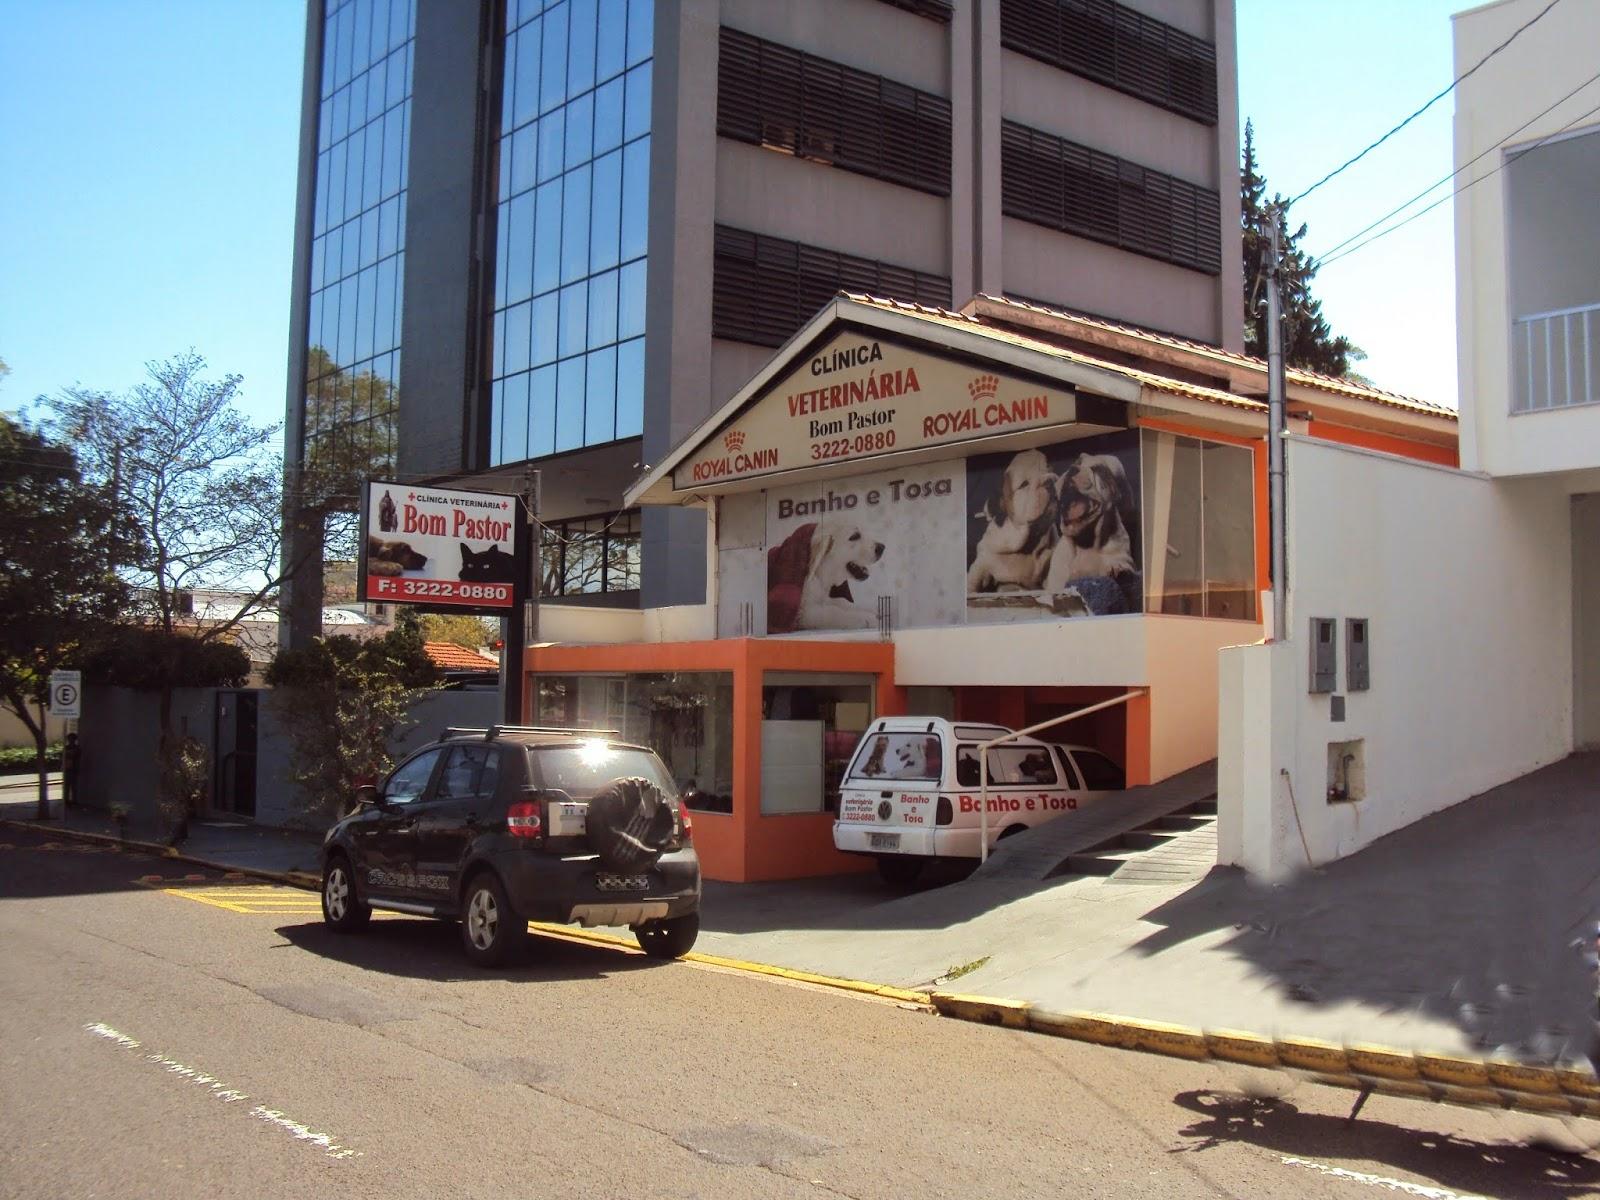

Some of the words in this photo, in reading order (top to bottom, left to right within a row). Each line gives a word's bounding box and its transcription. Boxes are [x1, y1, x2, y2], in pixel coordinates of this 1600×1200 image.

[811, 342, 883, 376] CLÍNICA
[787, 367, 921, 417] VETERINÁRIA
[809, 419, 843, 438] Bom
[848, 409, 896, 434] Pastor
[923, 407, 981, 438] ROYAL
[984, 395, 1048, 426] CANIN
[811, 429, 896, 460] 3222-0880
[693, 459, 733, 481] ROYAL
[734, 448, 779, 474] CANIN
[416, 494, 448, 505] CLÍNICA
[450, 497, 500, 510] VETERINÁRIA
[778, 491, 858, 519] Banho
[866, 490, 880, 505] e
[889, 478, 953, 503] Tosa
[403, 504, 447, 537] Bom
[452, 508, 512, 542] Pastor
[378, 579, 397, 593] F:
[404, 581, 507, 600] 3222-0880
[63, 688, 70, 702] E
[900, 794, 930, 805] Banho
[959, 795, 1021, 813] Banho
[1025, 798, 1035, 810] e
[1038, 793, 1078, 810] Tosa
[903, 813, 924, 823] Tosa
